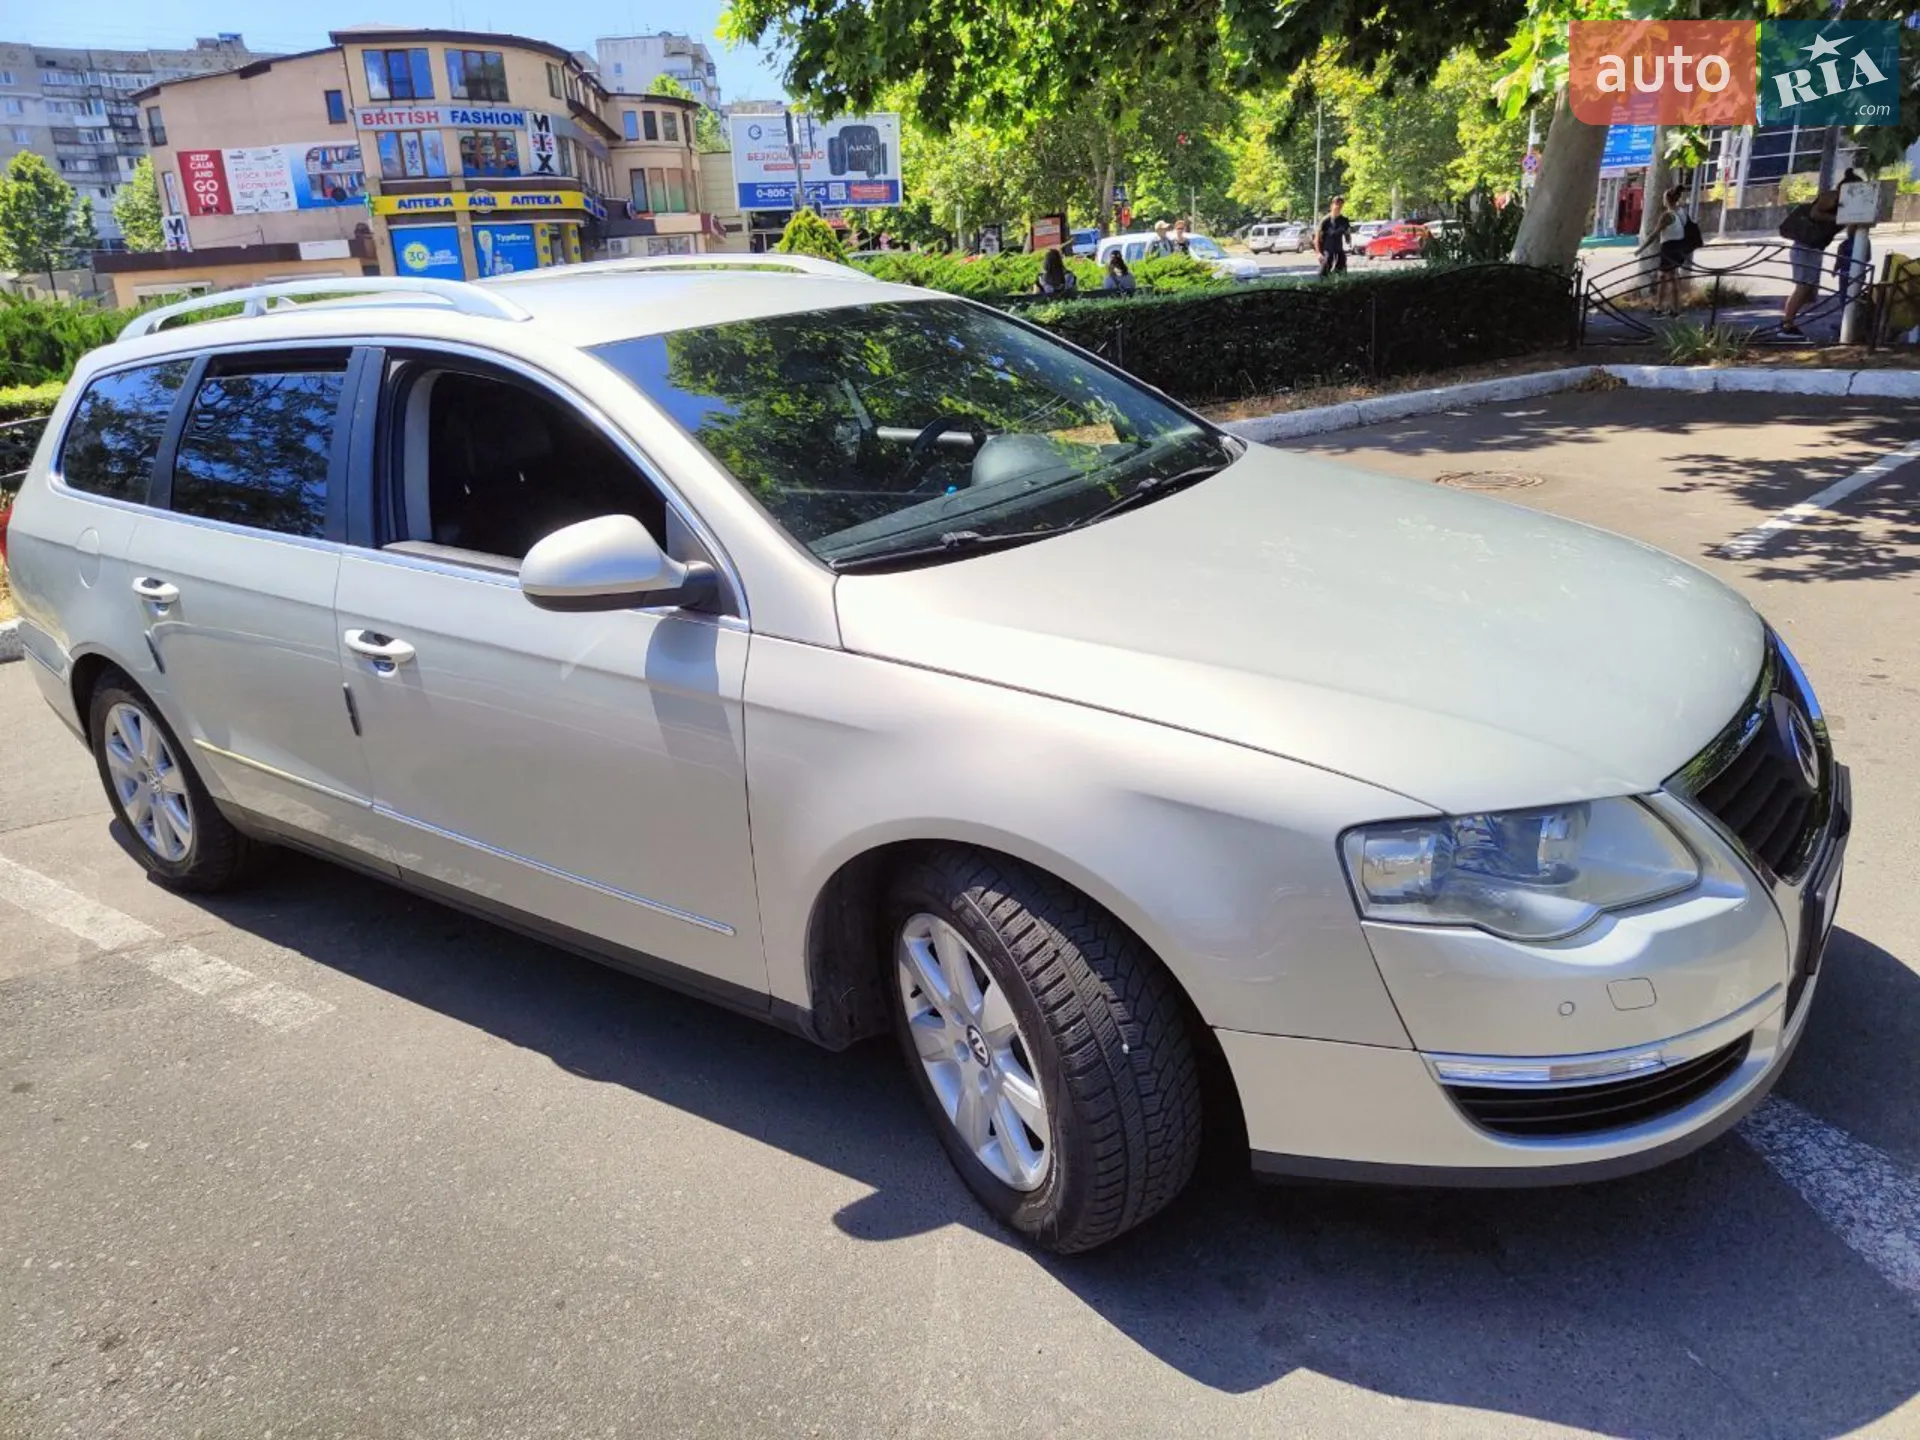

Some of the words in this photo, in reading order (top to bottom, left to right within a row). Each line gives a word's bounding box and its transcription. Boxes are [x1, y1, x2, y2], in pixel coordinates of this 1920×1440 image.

[361, 110, 440, 126] BRITISH
[451, 110, 525, 125] FASHION
[532, 113, 555, 173] MIX
[190, 161, 215, 170] CALM
[193, 179, 218, 192] GO
[198, 193, 218, 205] TO
[397, 197, 453, 210] АПТЕКА
[468, 195, 497, 207] АНЦ
[511, 194, 563, 205] АПТЕКА
